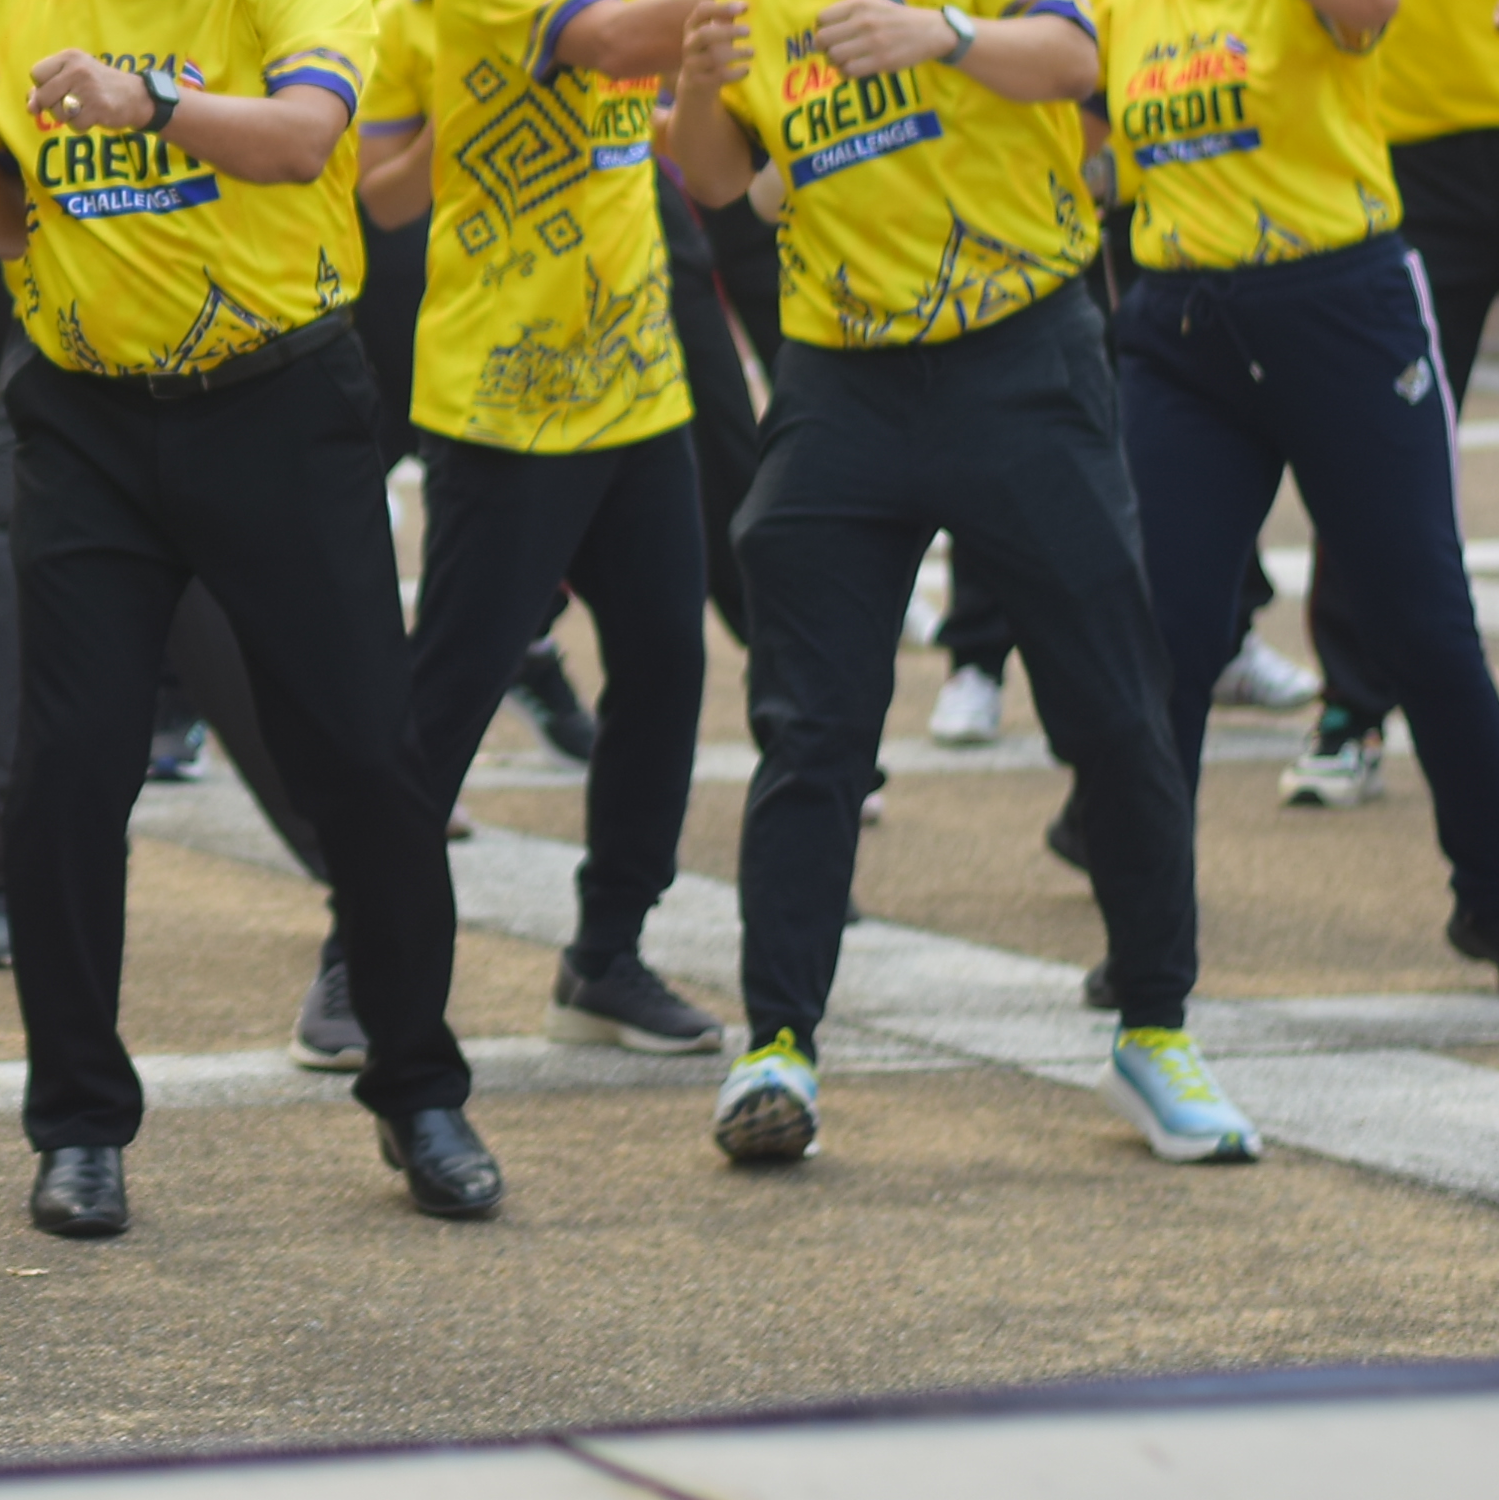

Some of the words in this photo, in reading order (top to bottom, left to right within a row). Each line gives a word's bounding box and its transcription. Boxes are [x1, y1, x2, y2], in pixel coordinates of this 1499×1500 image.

[785, 29, 817, 64] NA
[1123, 82, 1249, 141] CREDIT
[811, 118, 919, 174] CHALLENGE
[67, 187, 182, 214] CHALLENGE
